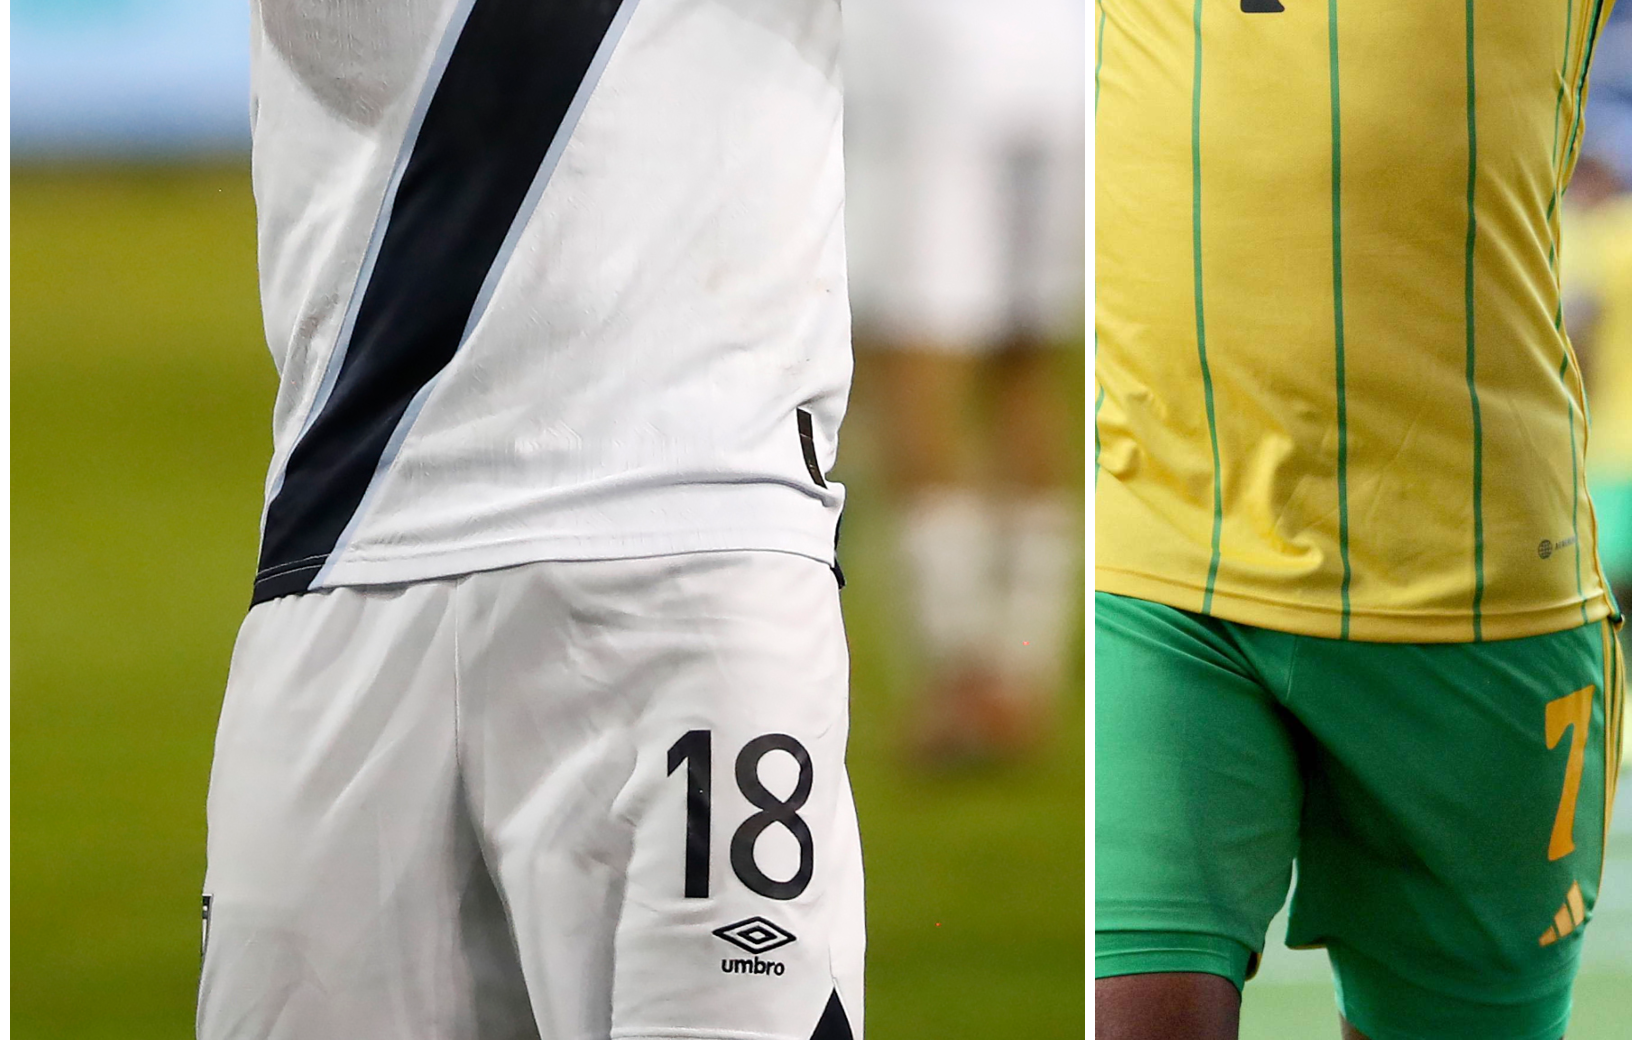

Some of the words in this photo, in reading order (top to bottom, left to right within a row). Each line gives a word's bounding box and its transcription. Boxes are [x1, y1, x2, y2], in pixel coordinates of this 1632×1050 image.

[666, 729, 814, 901] 18
[1545, 684, 1596, 862] 7
[721, 955, 786, 977] umbro
